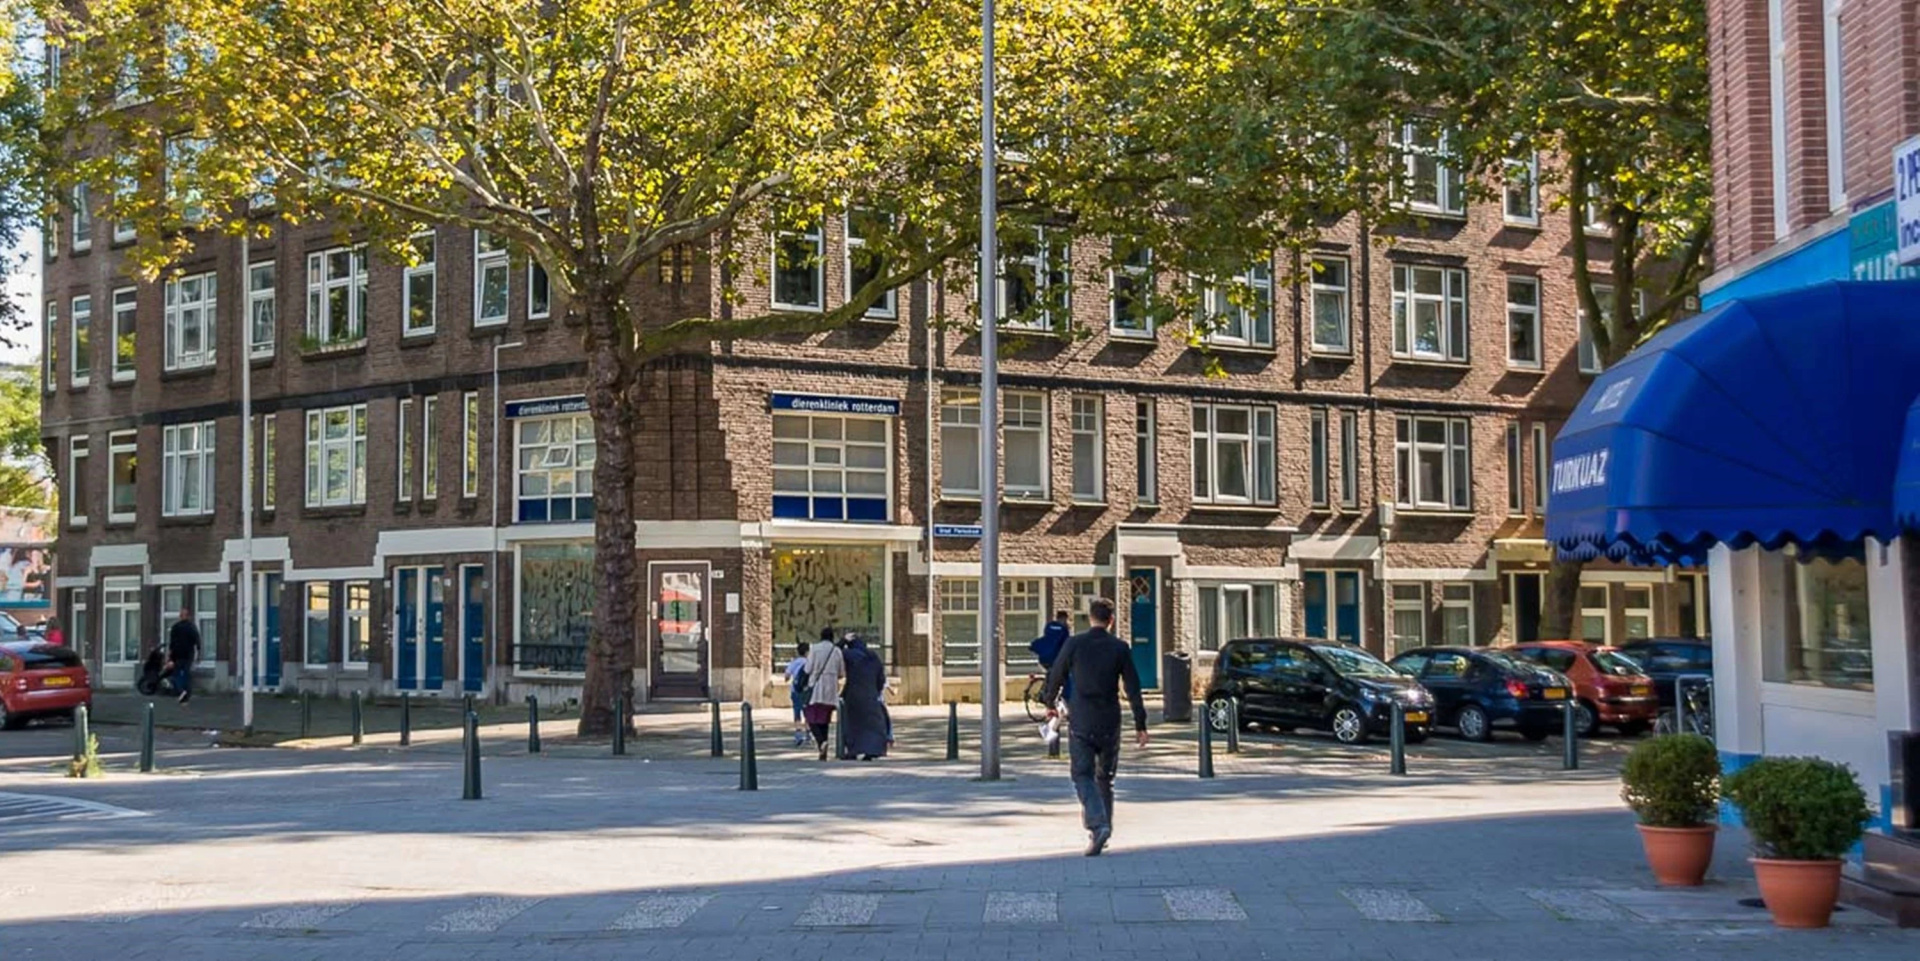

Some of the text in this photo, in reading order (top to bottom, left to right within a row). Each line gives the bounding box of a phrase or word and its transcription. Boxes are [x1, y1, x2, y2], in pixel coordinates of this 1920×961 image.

[1898, 157, 1907, 201] 2
[791, 398, 895, 413] dierenkliniek rotterdam
[1551, 447, 1609, 494] TURKUAZ
